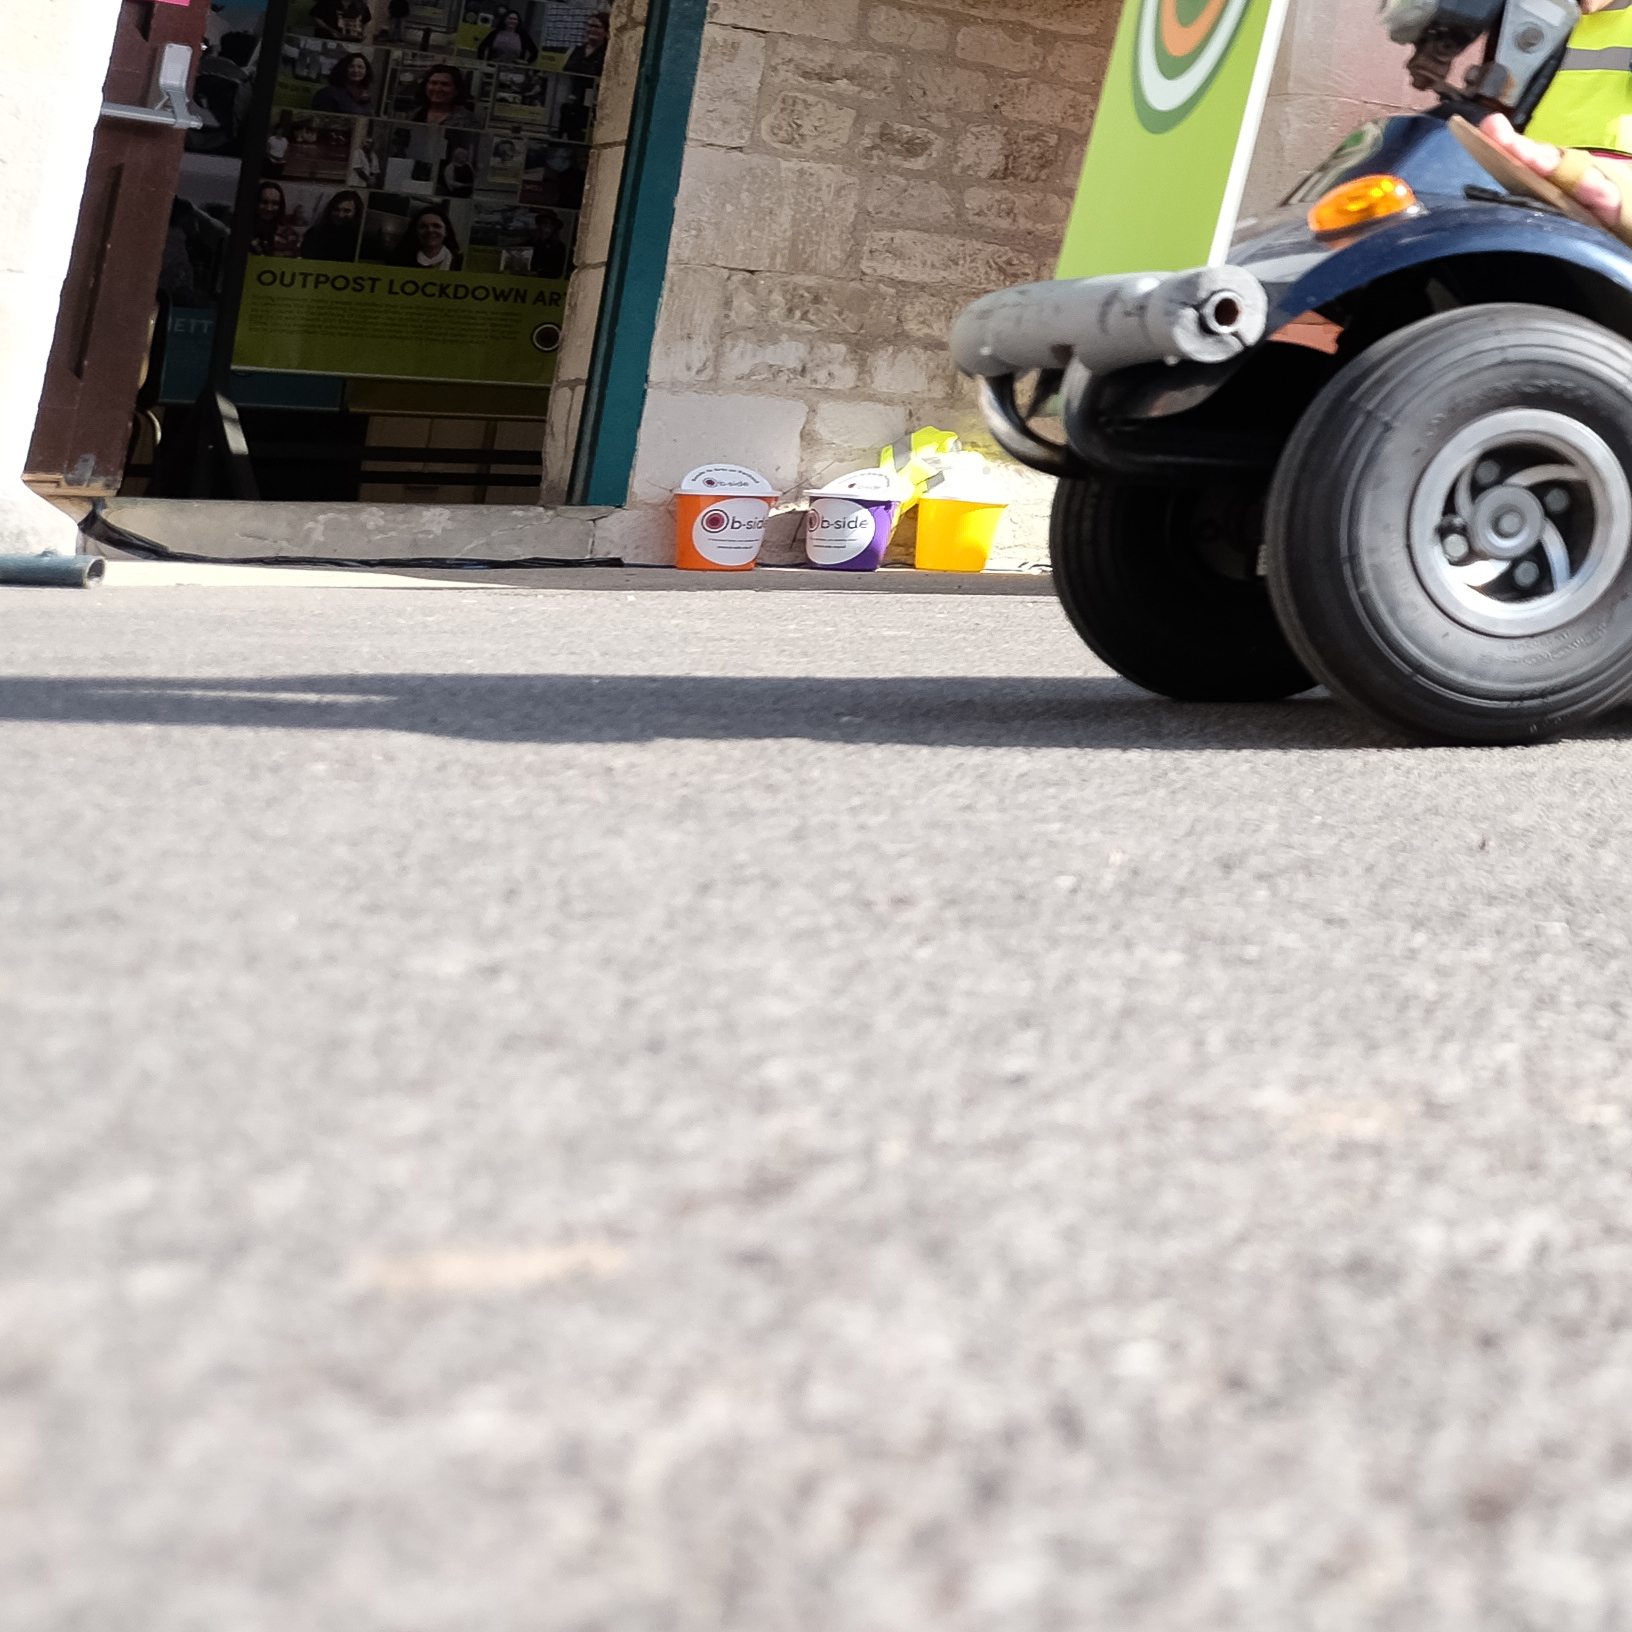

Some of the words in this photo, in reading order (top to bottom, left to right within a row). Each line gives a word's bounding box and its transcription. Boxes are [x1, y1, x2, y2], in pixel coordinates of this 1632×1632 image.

[257, 269, 381, 293] OUTPOST
[387, 279, 528, 304] LOCKDOWN
[821, 516, 869, 530] b-side
